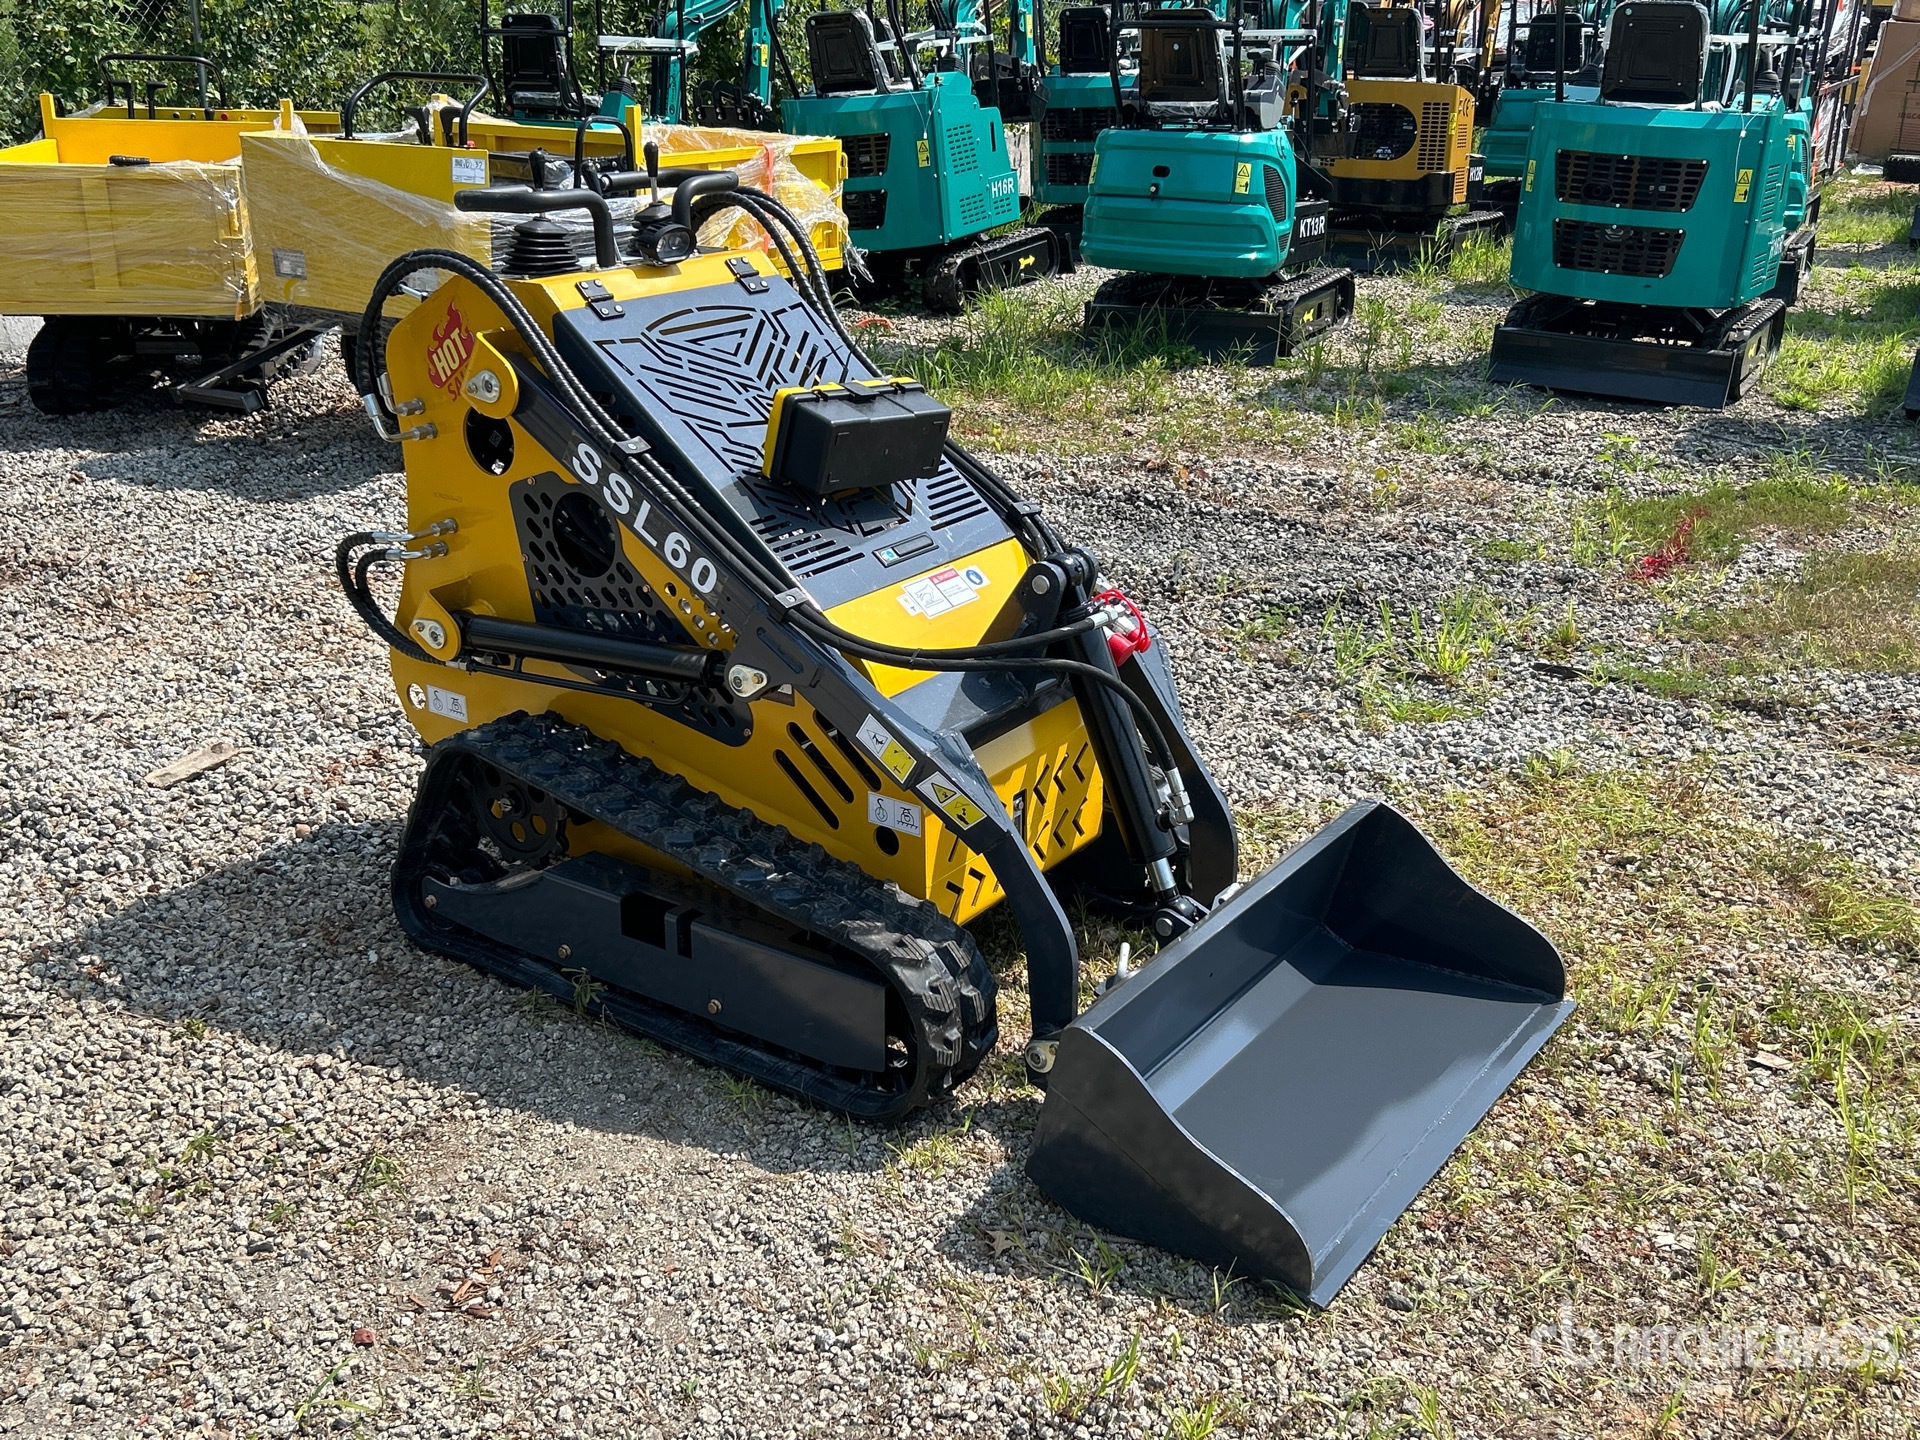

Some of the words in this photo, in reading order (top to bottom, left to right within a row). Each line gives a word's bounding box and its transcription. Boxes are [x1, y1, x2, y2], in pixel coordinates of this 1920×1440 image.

[991, 177, 1015, 199] H16R
[1299, 215, 1326, 239] KT13R
[432, 327, 467, 383] HOT
[572, 443, 718, 594] SSL60
